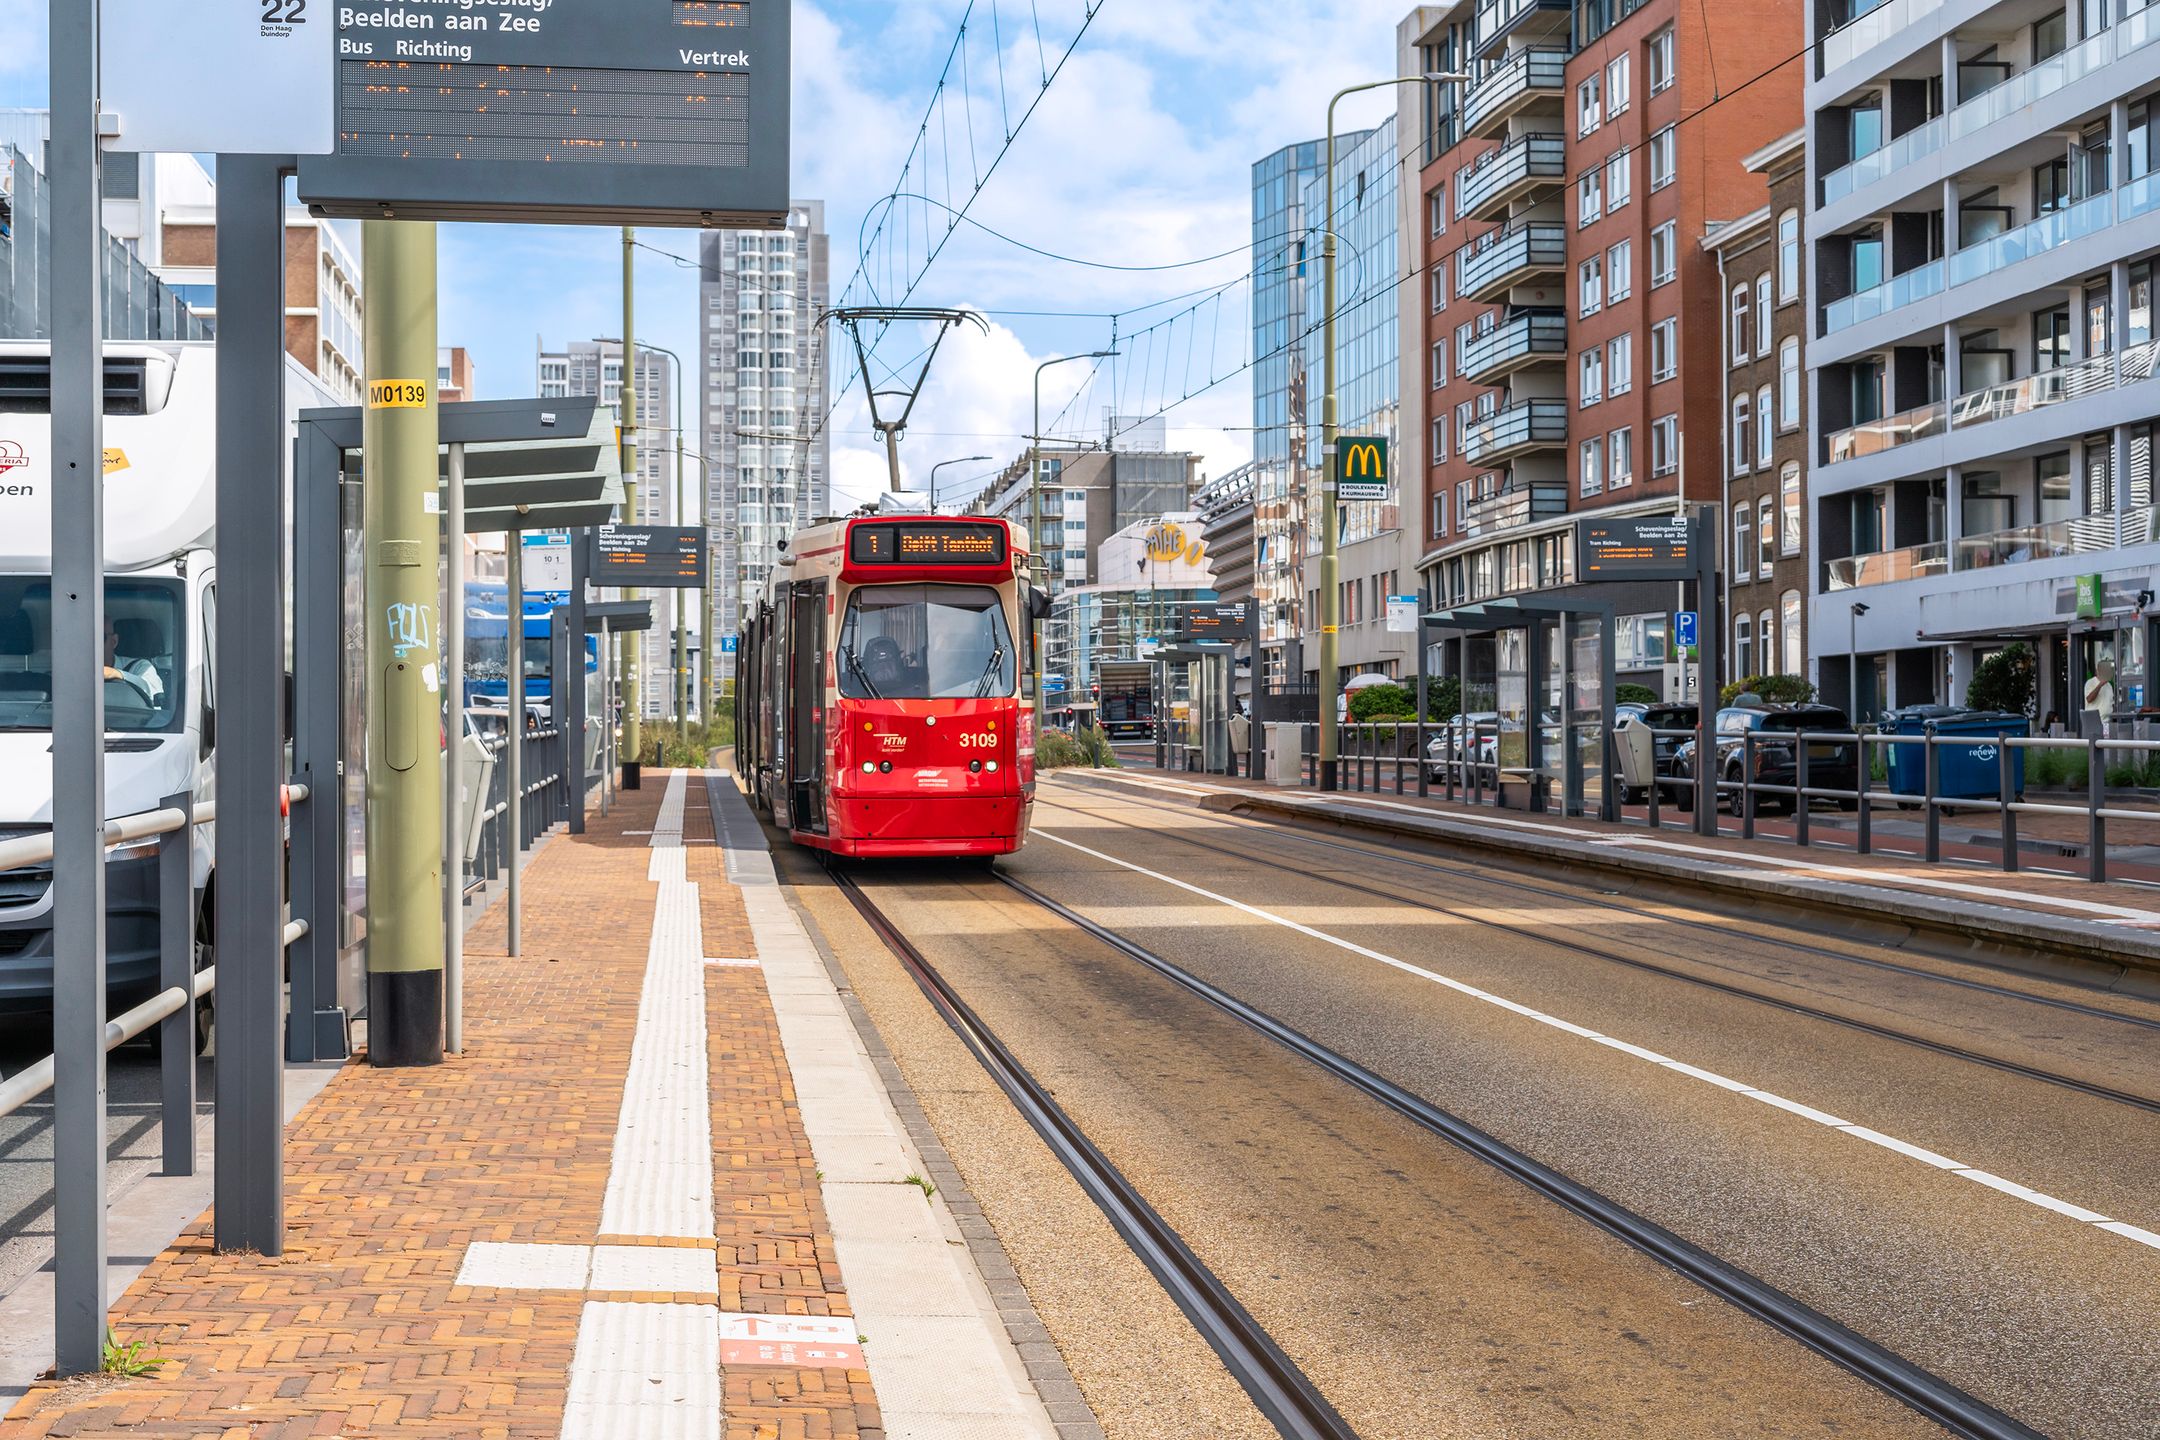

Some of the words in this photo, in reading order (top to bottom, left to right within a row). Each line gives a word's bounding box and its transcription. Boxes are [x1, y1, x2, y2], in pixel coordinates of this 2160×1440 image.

[261, 0, 307, 24] 22
[340, 8, 434, 29] Beelden
[444, 15, 488, 30] aan
[499, 13, 541, 32] Zee
[340, 38, 373, 54] Bus
[396, 40, 472, 61] Richting
[679, 50, 750, 67] Vertrek
[370, 385, 425, 404] M0139
[869, 535, 878, 553] 1
[902, 535, 938, 552] Delft
[1680, 614, 1692, 631] P
[726, 640, 734, 650] P
[883, 736, 908, 746] HTM
[959, 733, 998, 748] 3109
